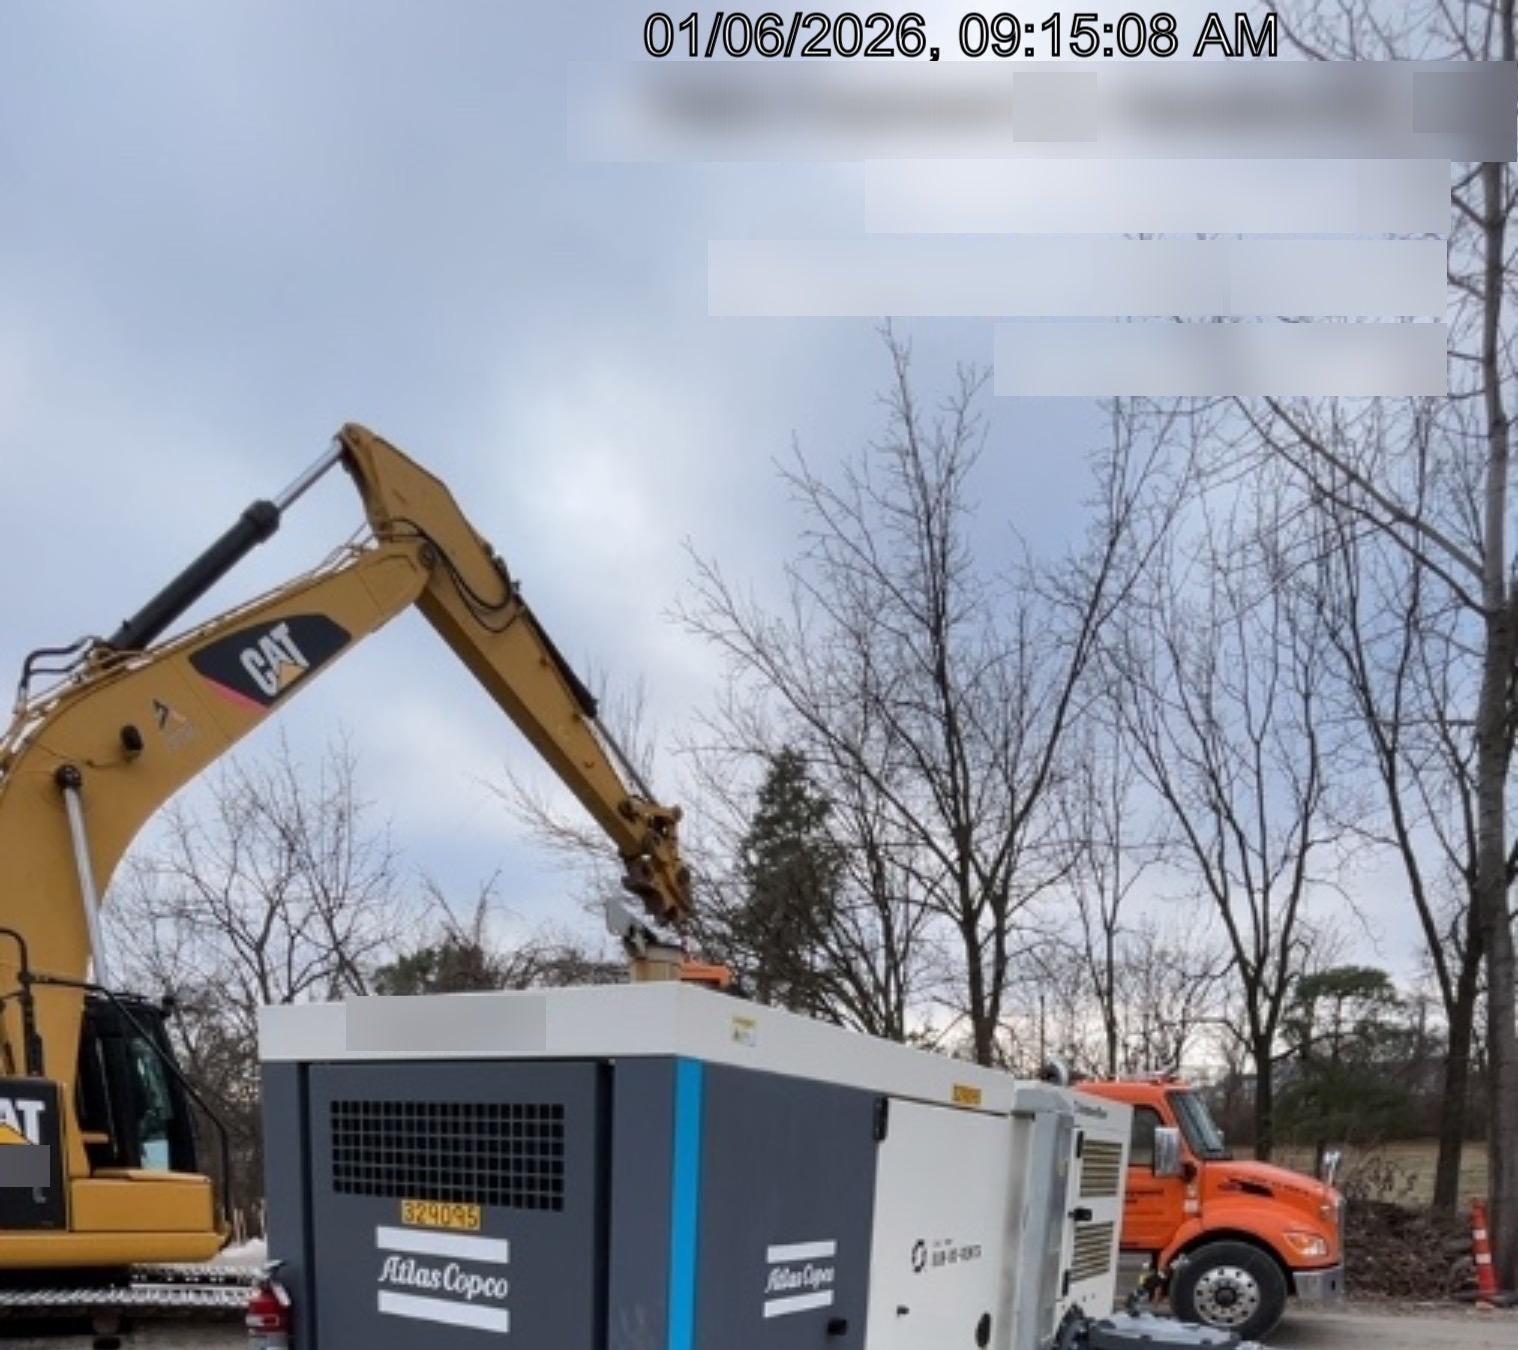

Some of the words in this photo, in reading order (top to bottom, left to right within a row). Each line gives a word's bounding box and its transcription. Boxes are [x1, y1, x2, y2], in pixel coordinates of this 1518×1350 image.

[239, 622, 310, 696] CAT
[0, 1098, 46, 1145] AT
[377, 1255, 442, 1290] Atlas
[442, 1262, 509, 1300] Copco
